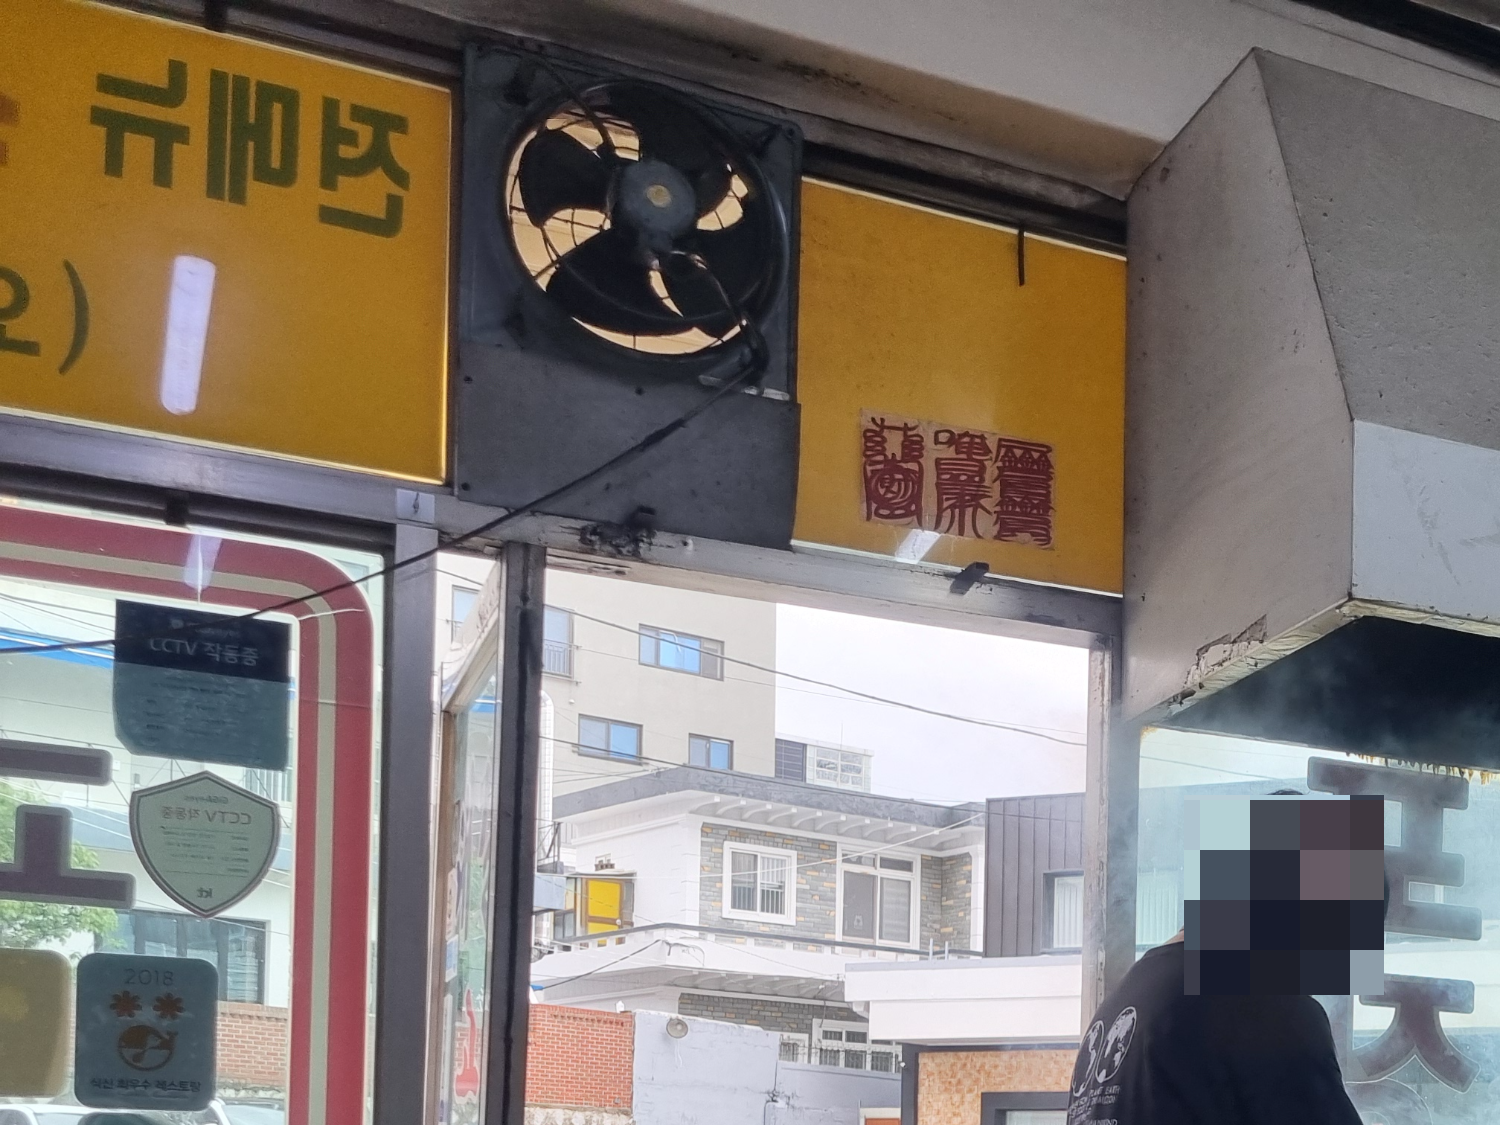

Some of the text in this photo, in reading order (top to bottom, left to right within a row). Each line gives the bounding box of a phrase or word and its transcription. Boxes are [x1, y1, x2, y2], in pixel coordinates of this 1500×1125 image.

[149, 637, 260, 667] CCTV 작동중
[123, 968, 174, 987] 2018
[155, 1080, 202, 1093] 레스토랑
